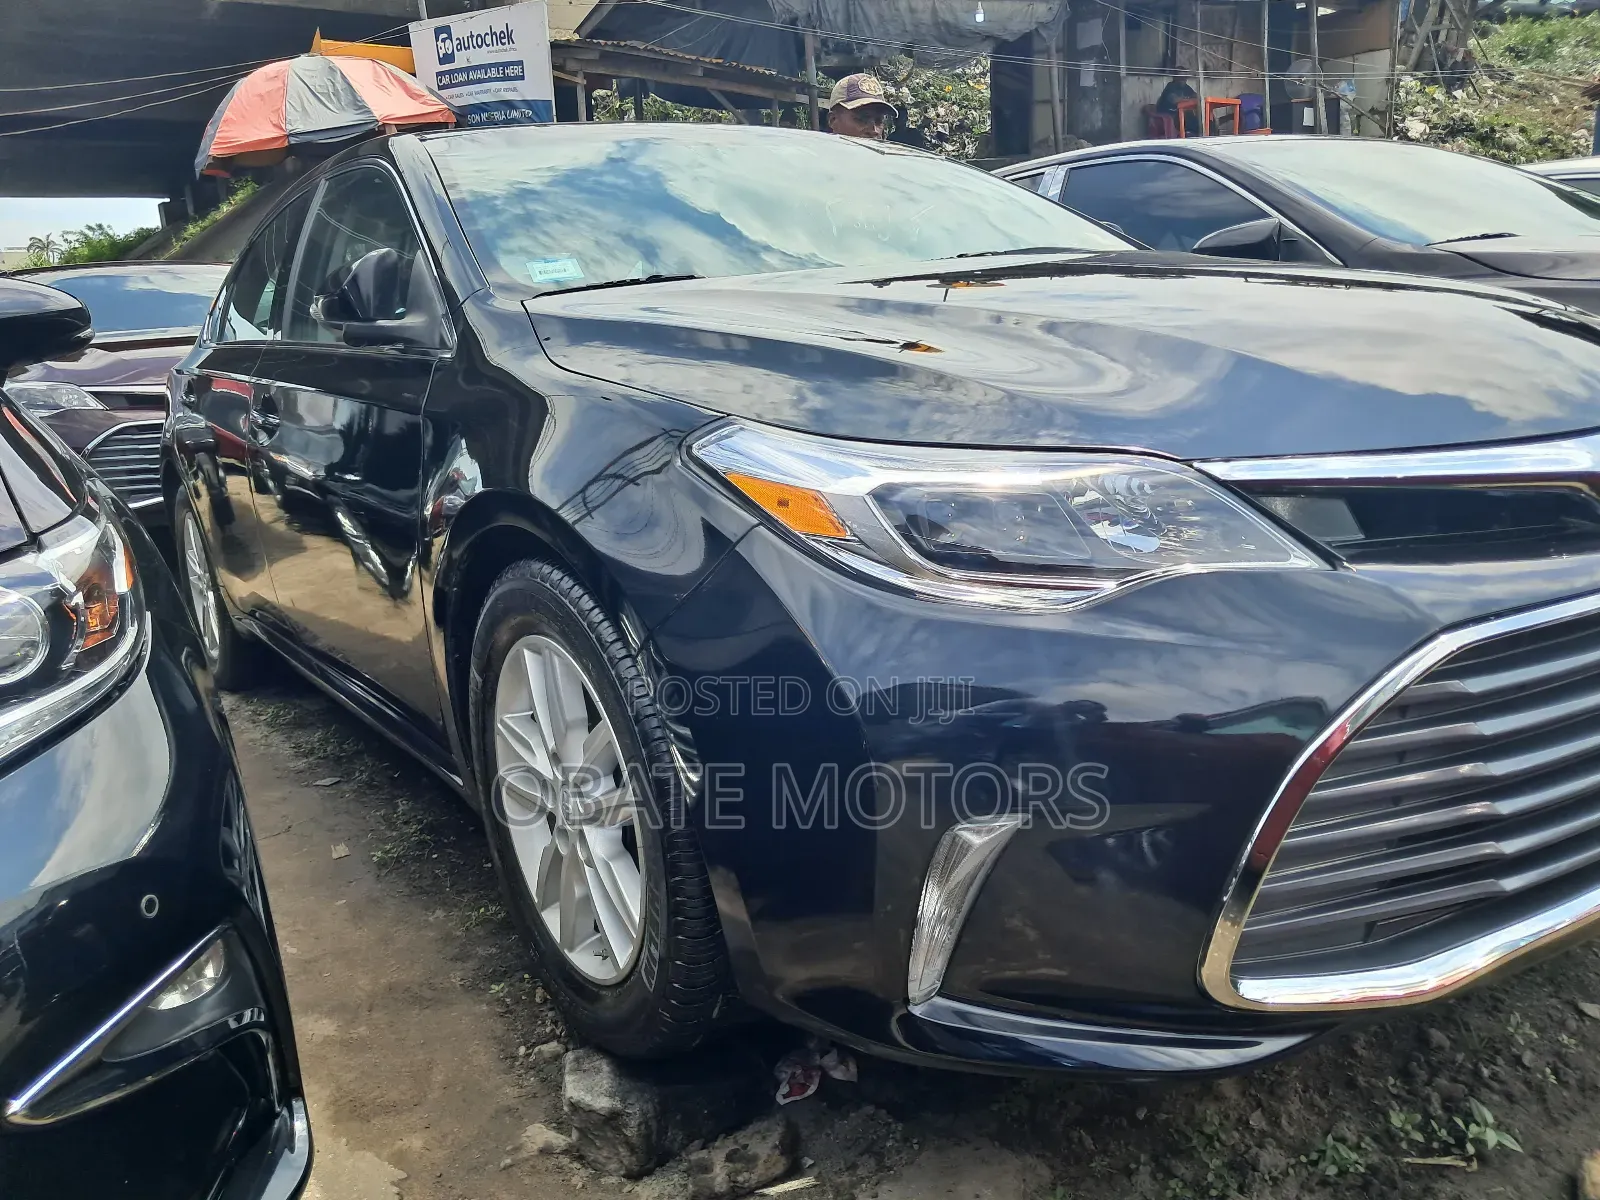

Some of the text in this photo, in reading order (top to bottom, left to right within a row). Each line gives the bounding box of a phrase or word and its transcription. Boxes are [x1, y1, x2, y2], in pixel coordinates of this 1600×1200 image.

[455, 23, 515, 52] autochek
[437, 65, 523, 86] CAR LOAN AVAILABLE HERE
